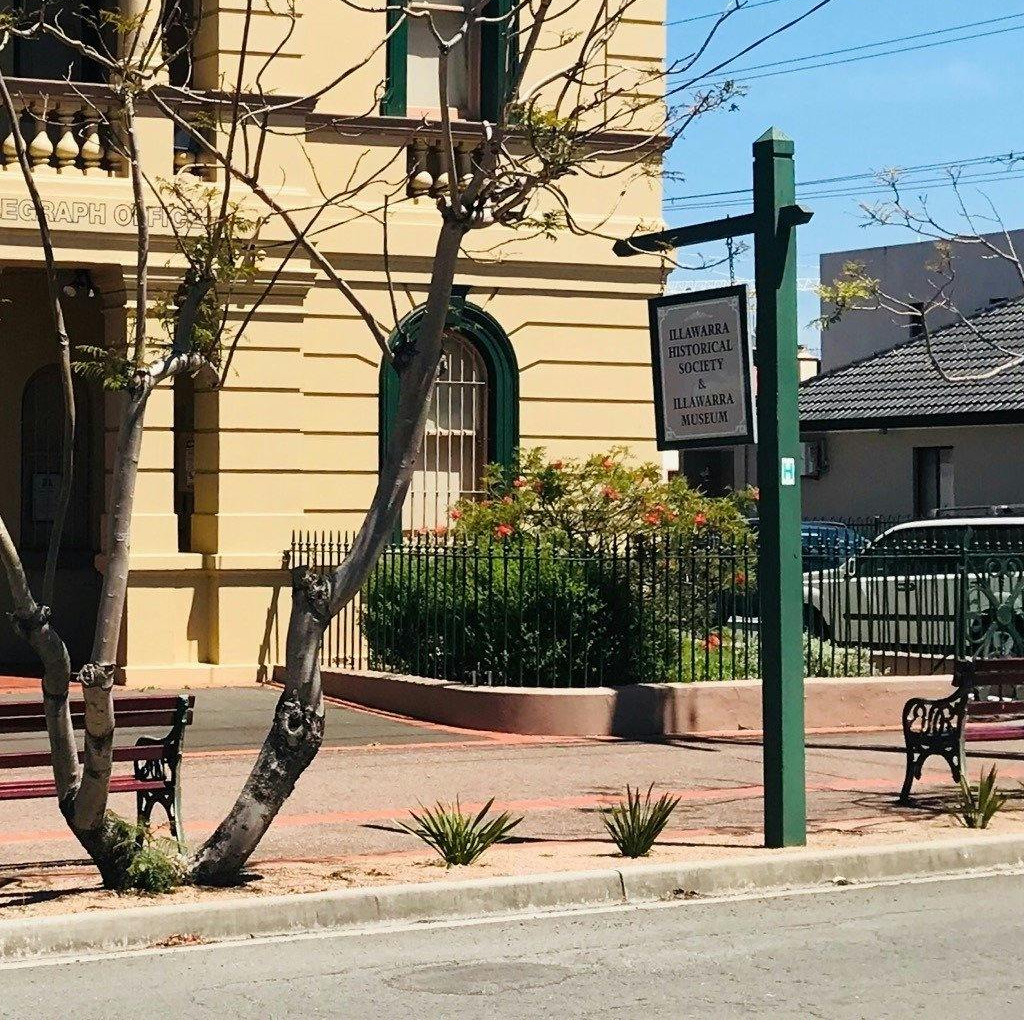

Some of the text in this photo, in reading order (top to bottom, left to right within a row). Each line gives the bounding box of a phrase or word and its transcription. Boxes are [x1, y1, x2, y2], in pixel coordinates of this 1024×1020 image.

[669, 322, 730, 341] ILLAWARRA
[668, 339, 733, 359] HISTORICAL
[678, 358, 724, 375] SOCIETY
[697, 378, 707, 390] &
[673, 393, 735, 410] ILLAWARRA
[681, 410, 729, 427] MUSEUM
